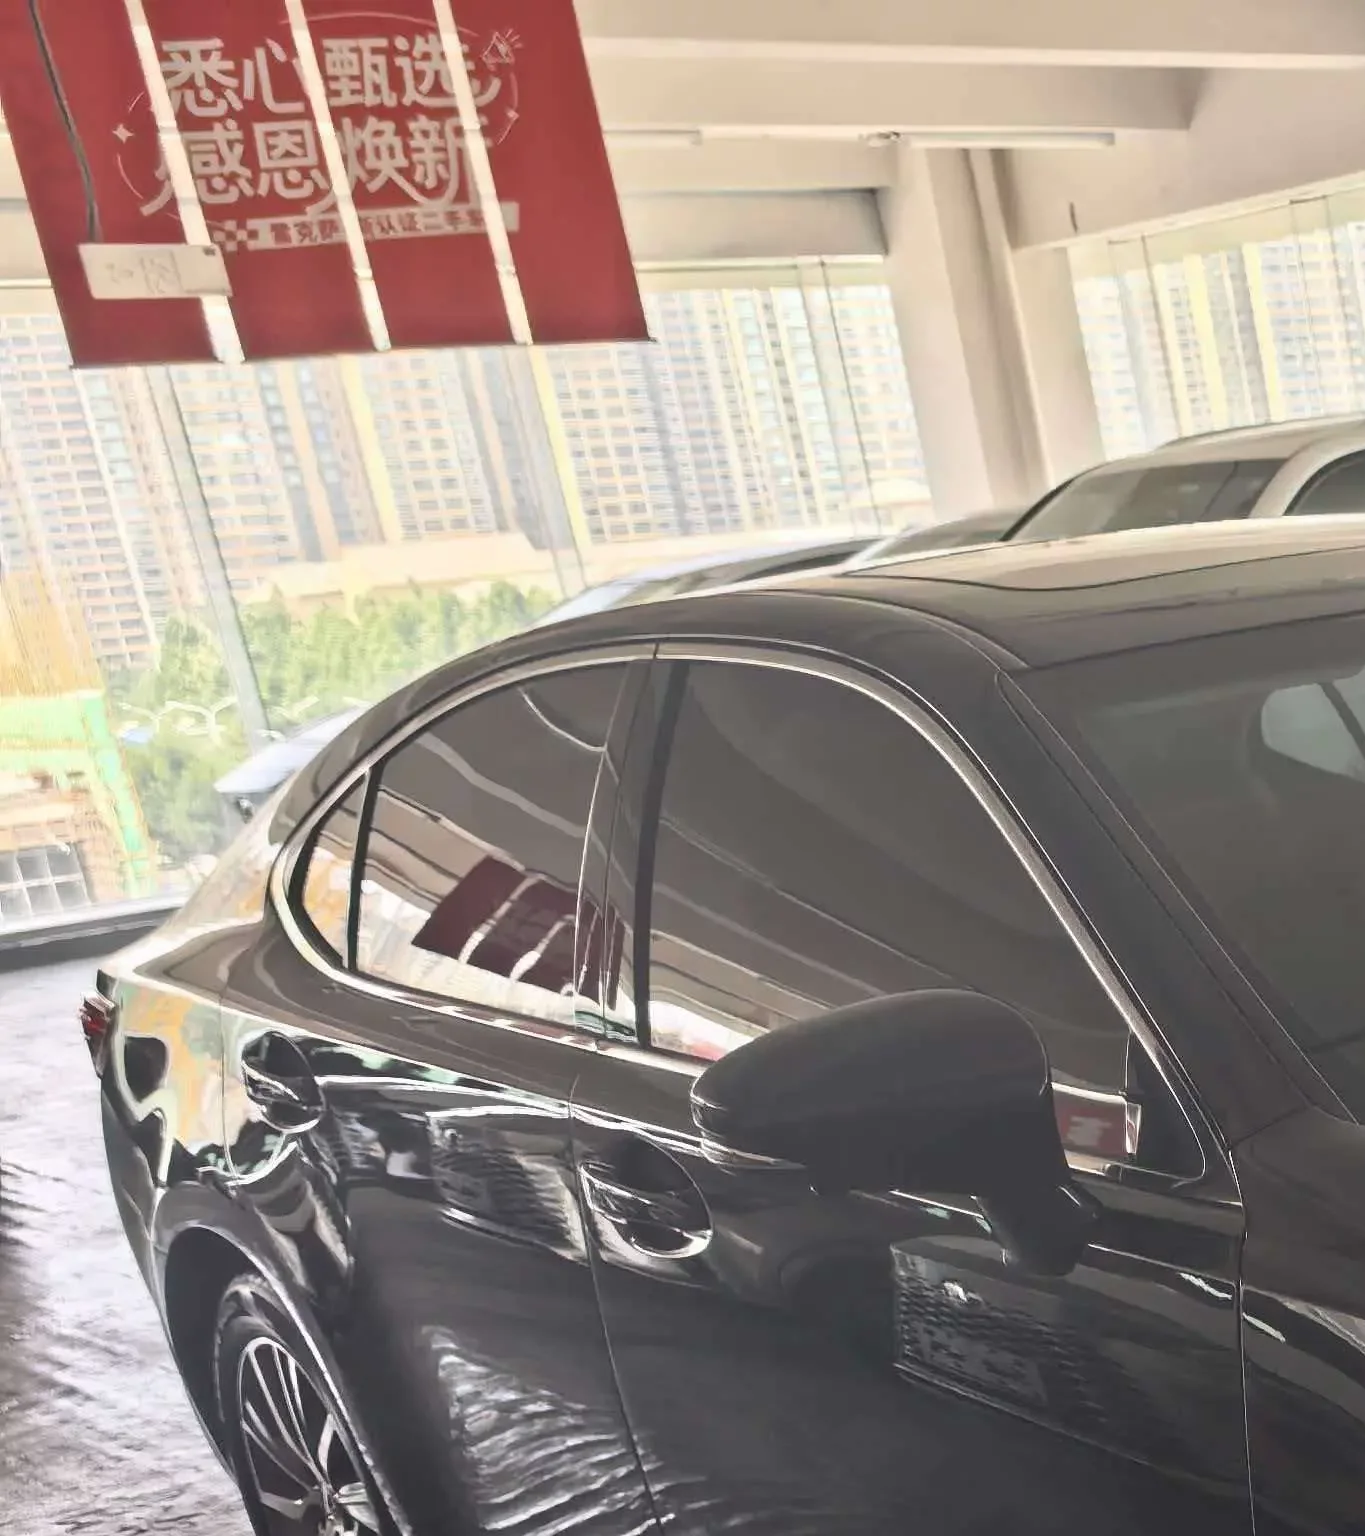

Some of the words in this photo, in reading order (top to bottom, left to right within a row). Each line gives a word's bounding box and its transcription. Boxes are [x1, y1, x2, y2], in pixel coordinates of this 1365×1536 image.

[152, 33, 501, 117] 悉心甄选
[139, 113, 493, 216] 感恩焕新
